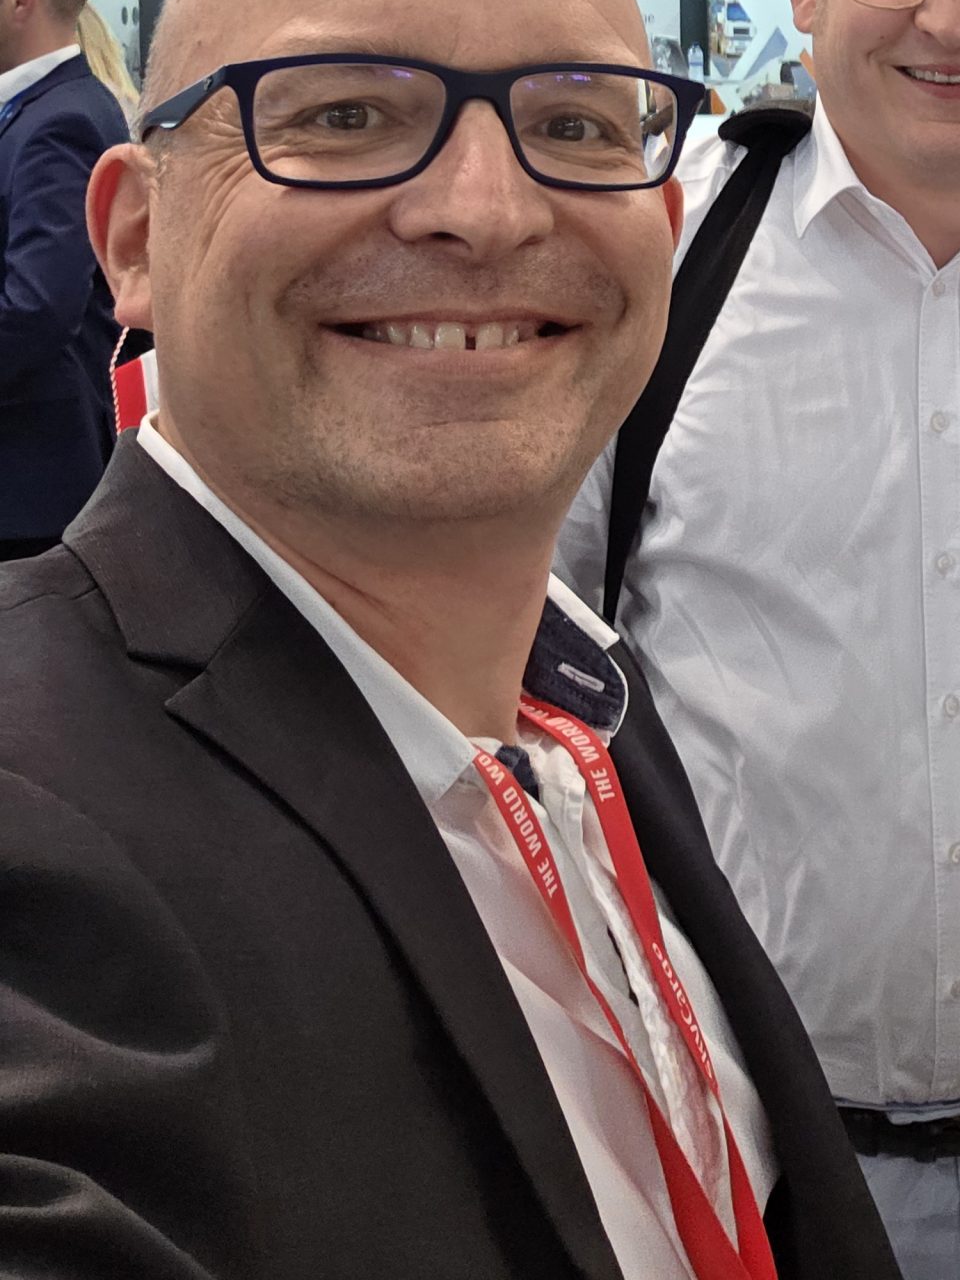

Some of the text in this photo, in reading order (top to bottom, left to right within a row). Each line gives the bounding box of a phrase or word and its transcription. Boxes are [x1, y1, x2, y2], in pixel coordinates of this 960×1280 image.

[590, 767, 616, 803] THE
[501, 785, 543, 858] WORLD
[537, 857, 559, 899] THE
